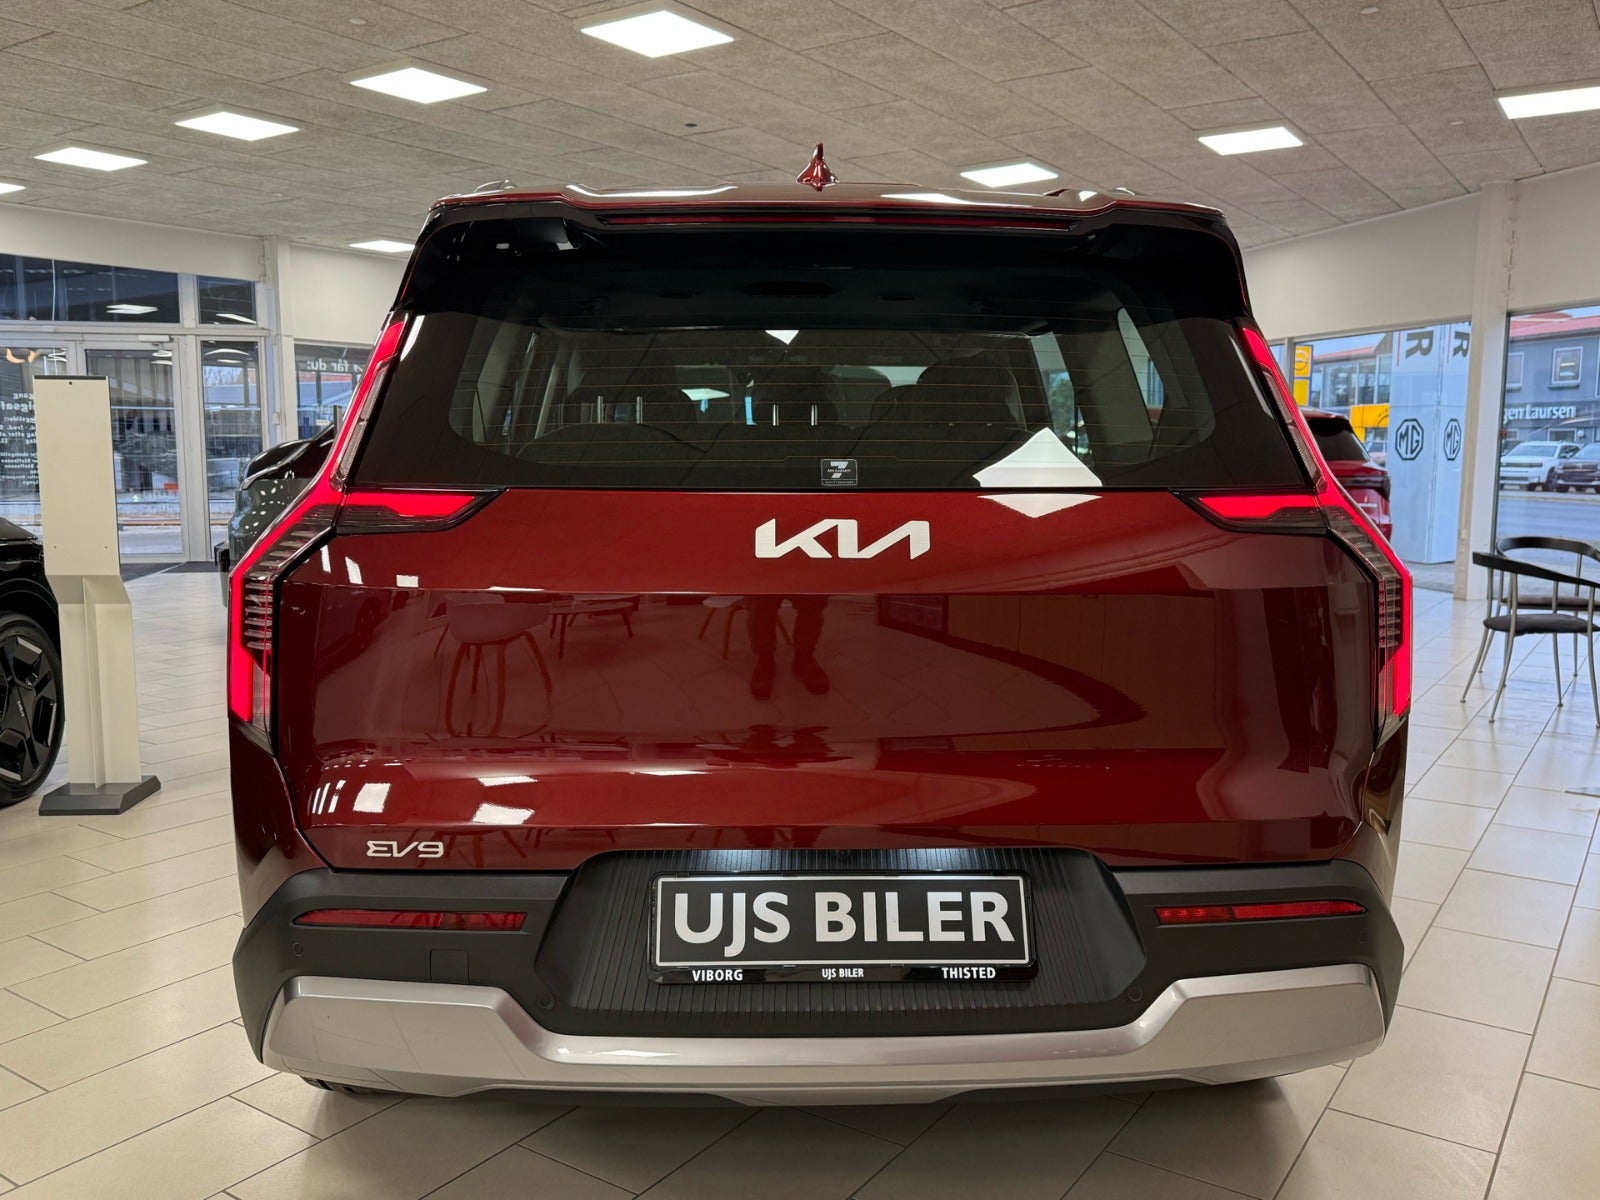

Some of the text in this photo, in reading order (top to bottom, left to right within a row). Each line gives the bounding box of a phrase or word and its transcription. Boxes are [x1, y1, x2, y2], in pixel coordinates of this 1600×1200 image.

[1525, 404, 1578, 420] Laursen
[1397, 422, 1422, 457] MG
[1445, 422, 1460, 457] MG
[755, 518, 931, 560] KIA
[366, 840, 445, 859] EV9
[674, 891, 1016, 958] UJS BILER
[691, 968, 744, 982] VIBORG
[821, 968, 865, 980] UJS BILER
[941, 966, 996, 980] THISTED
